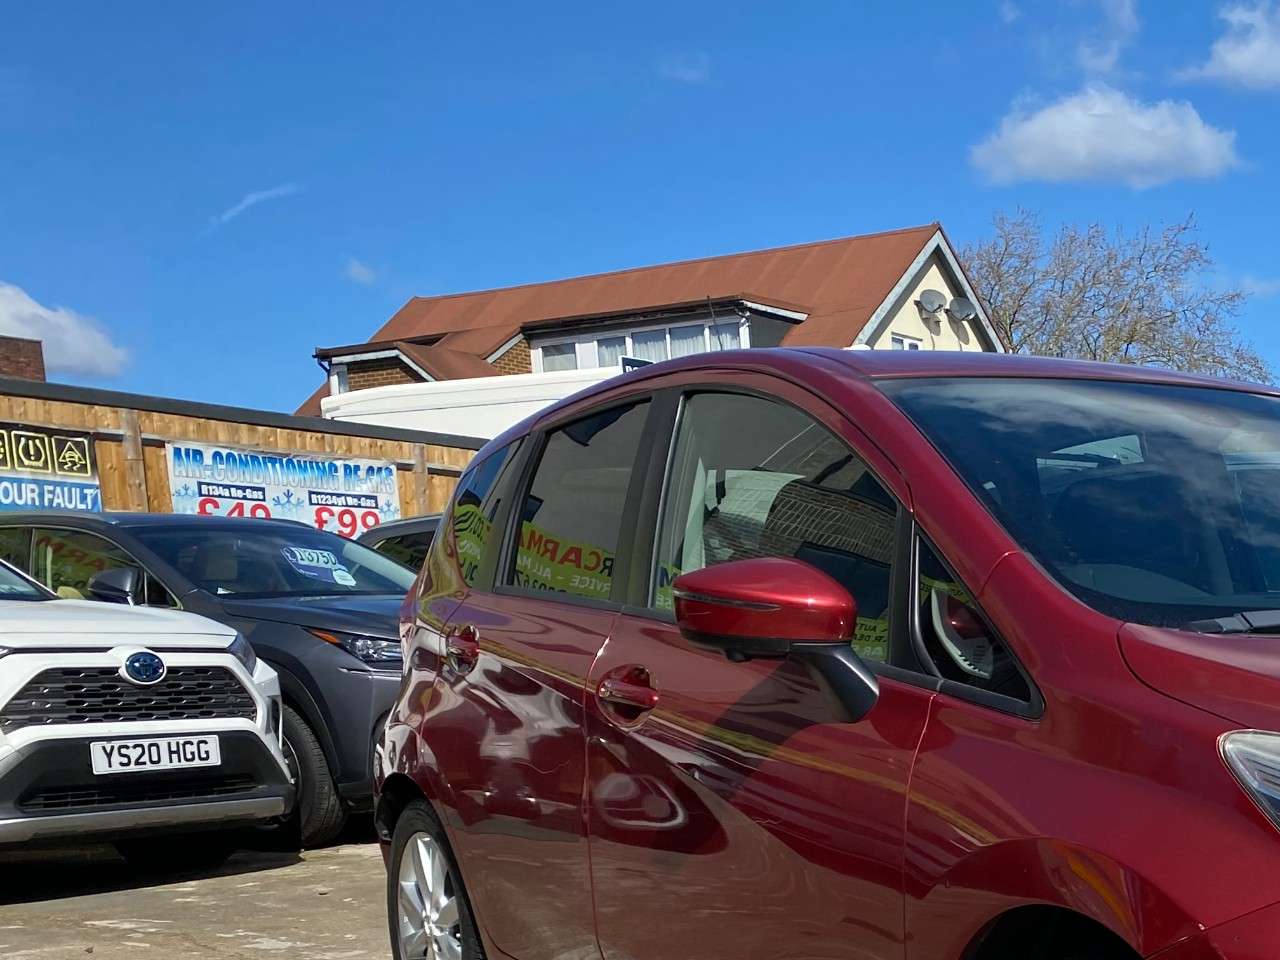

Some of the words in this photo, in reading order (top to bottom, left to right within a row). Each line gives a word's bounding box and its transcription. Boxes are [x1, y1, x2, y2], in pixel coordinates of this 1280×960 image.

[44, 484, 97, 510] FAULT
[314, 506, 381, 538] £99
[101, 742, 162, 769] YS20
[167, 739, 210, 764] HGG
